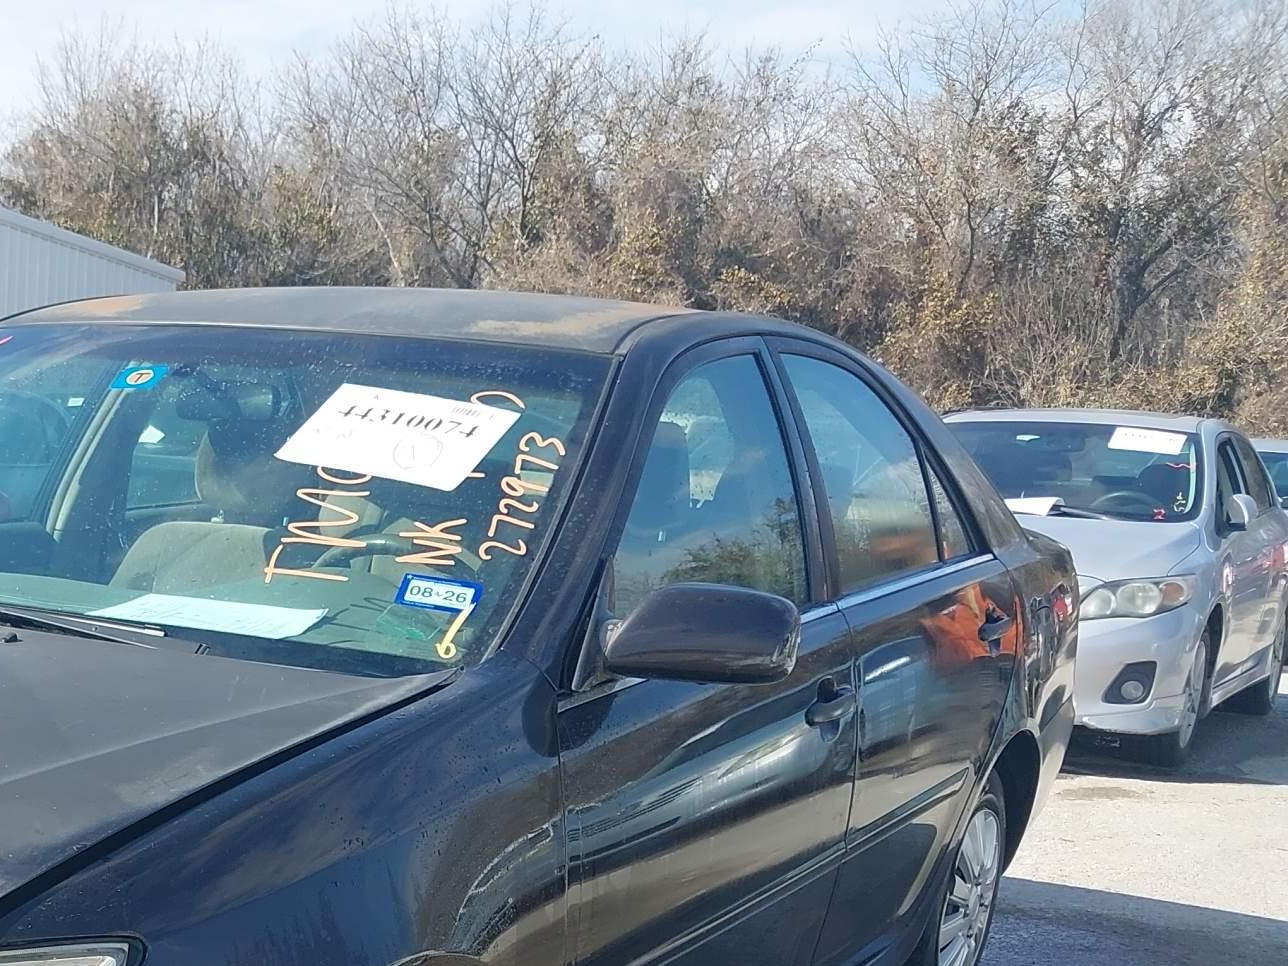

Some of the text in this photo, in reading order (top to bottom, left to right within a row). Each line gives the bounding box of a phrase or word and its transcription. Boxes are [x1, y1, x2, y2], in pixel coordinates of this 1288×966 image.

[338, 404, 481, 439] 44310074
[409, 585, 469, 603] 08 26
